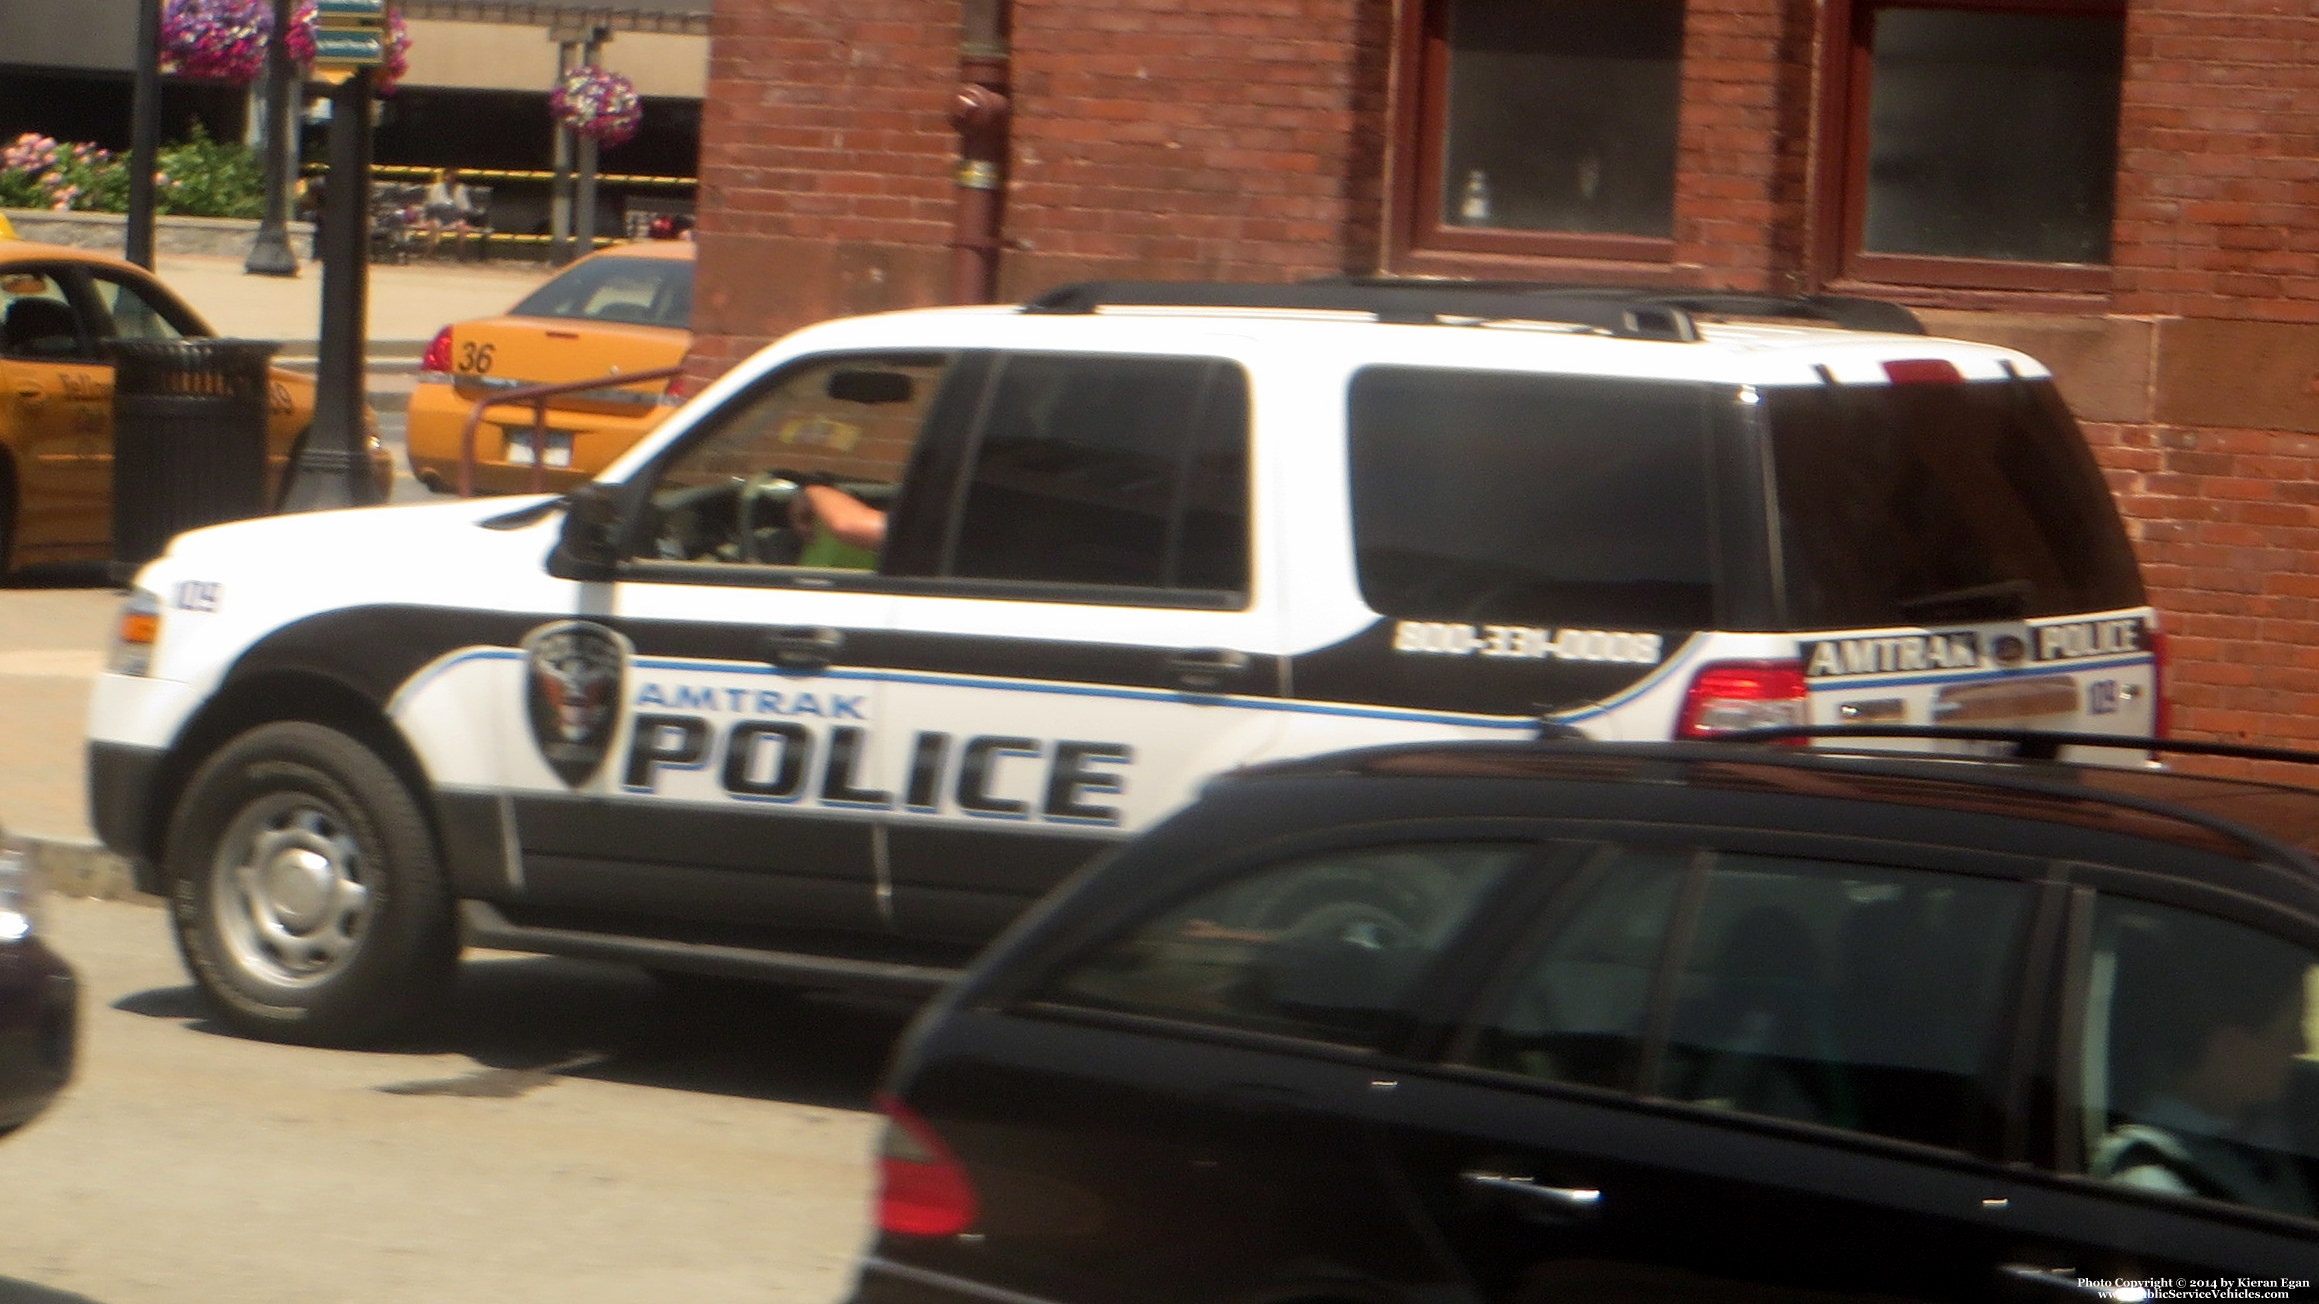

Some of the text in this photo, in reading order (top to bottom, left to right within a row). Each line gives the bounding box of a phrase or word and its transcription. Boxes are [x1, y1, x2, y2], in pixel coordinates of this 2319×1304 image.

[458, 341, 496, 374] 36
[1809, 618, 2140, 677] AMTRAK POLICE
[635, 681, 868, 720] AMTRAK
[623, 713, 1134, 827] POLICE
